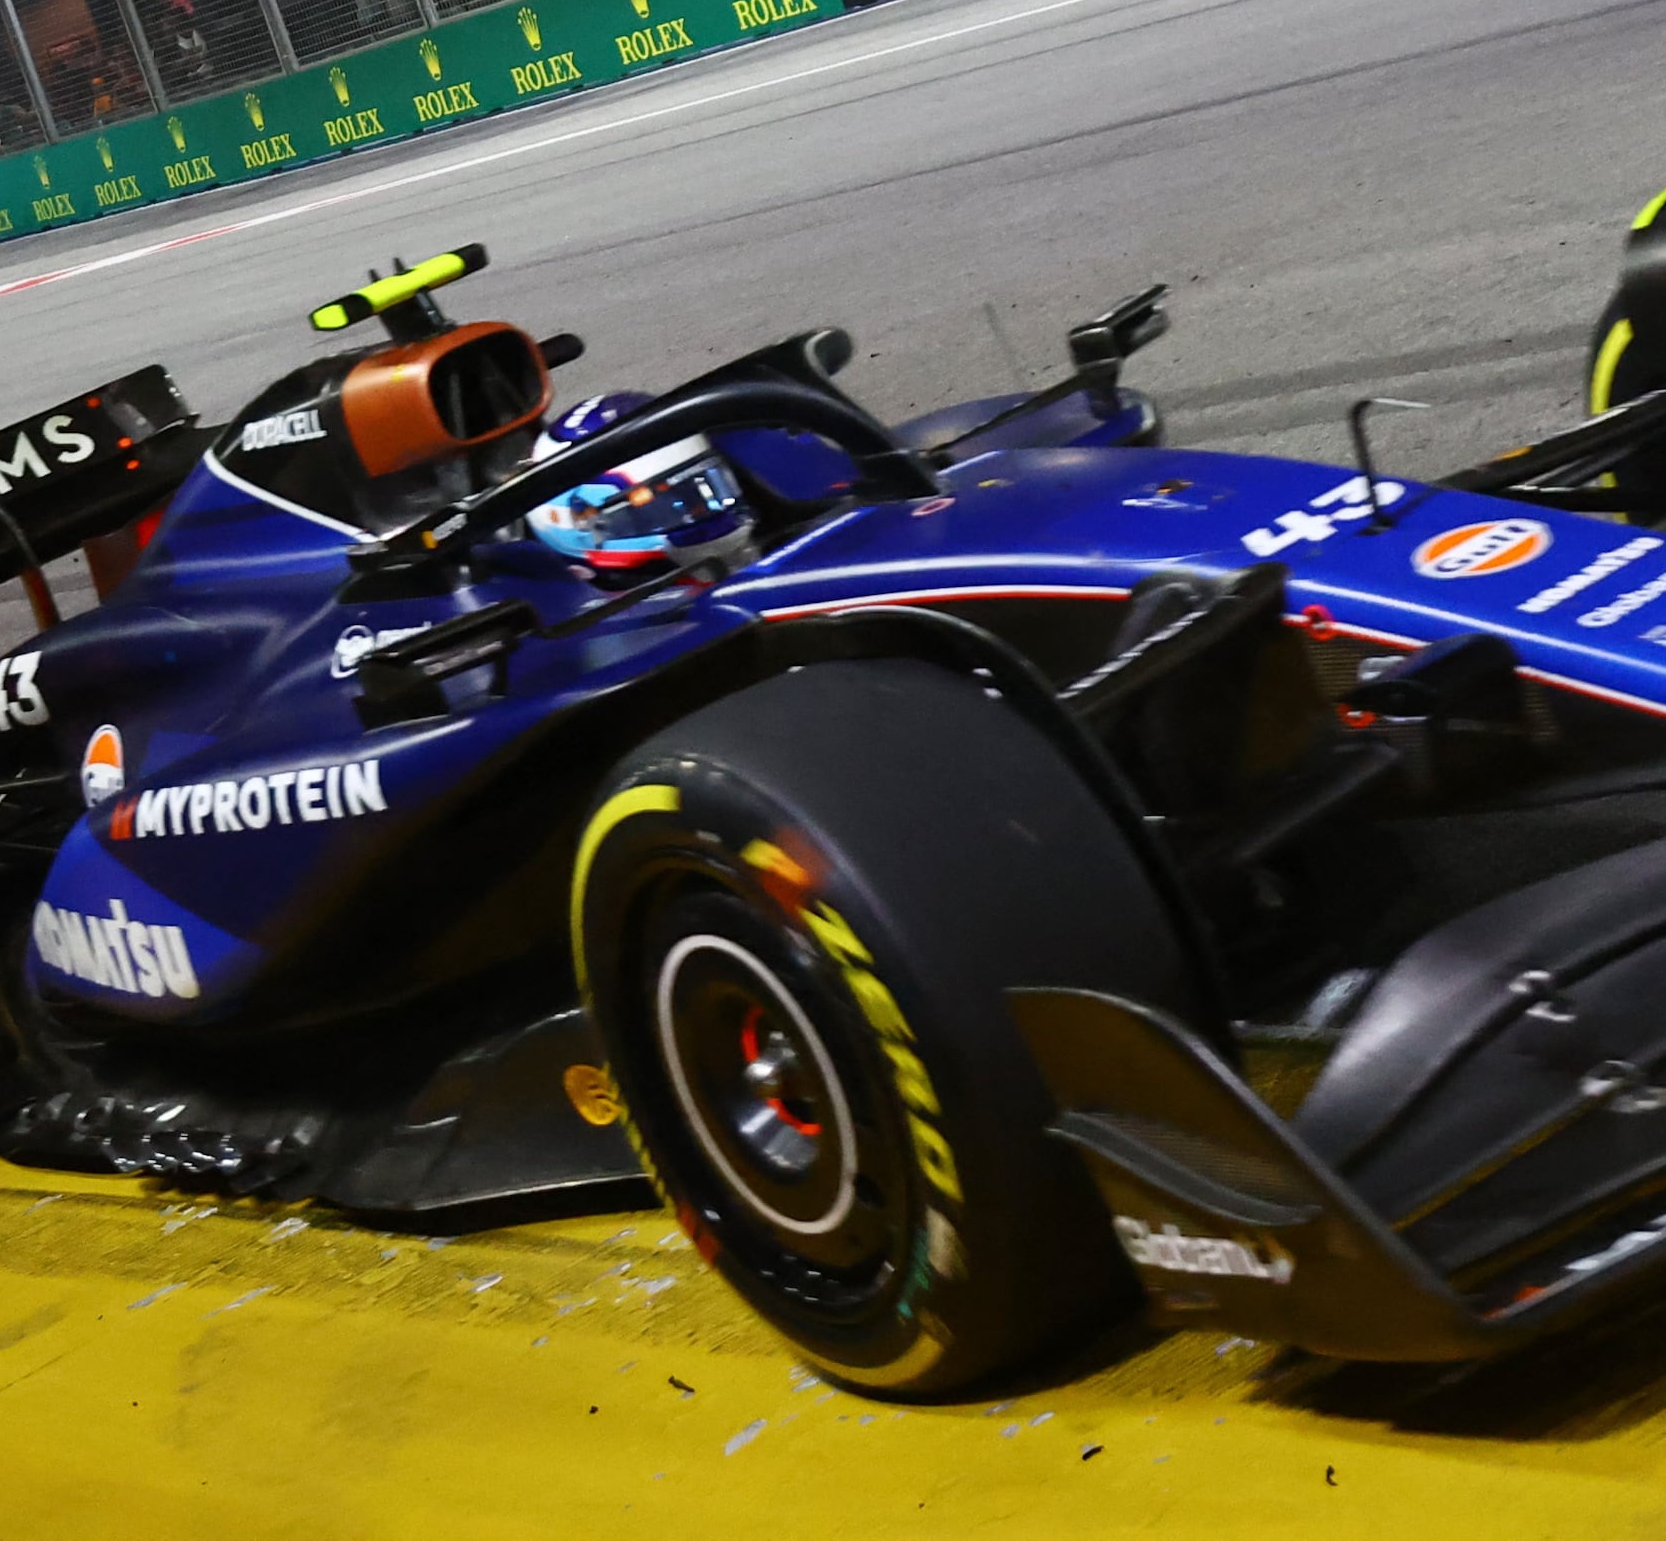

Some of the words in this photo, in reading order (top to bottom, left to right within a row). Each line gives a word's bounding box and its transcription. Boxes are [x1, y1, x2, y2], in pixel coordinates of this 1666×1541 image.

[615, 17, 693, 66] ROLEX
[511, 50, 583, 96] ROLEX
[413, 80, 479, 124] ROLEX
[323, 107, 384, 149] ROLEX
[163, 155, 217, 189] ROLEX
[240, 133, 296, 170] ROLEX
[31, 193, 76, 222] ROLEX
[94, 175, 142, 207] ROLEX
[242, 408, 327, 453] DURACELL
[1241, 474, 1407, 558] 43
[135, 759, 388, 838] MYPROTEIN
